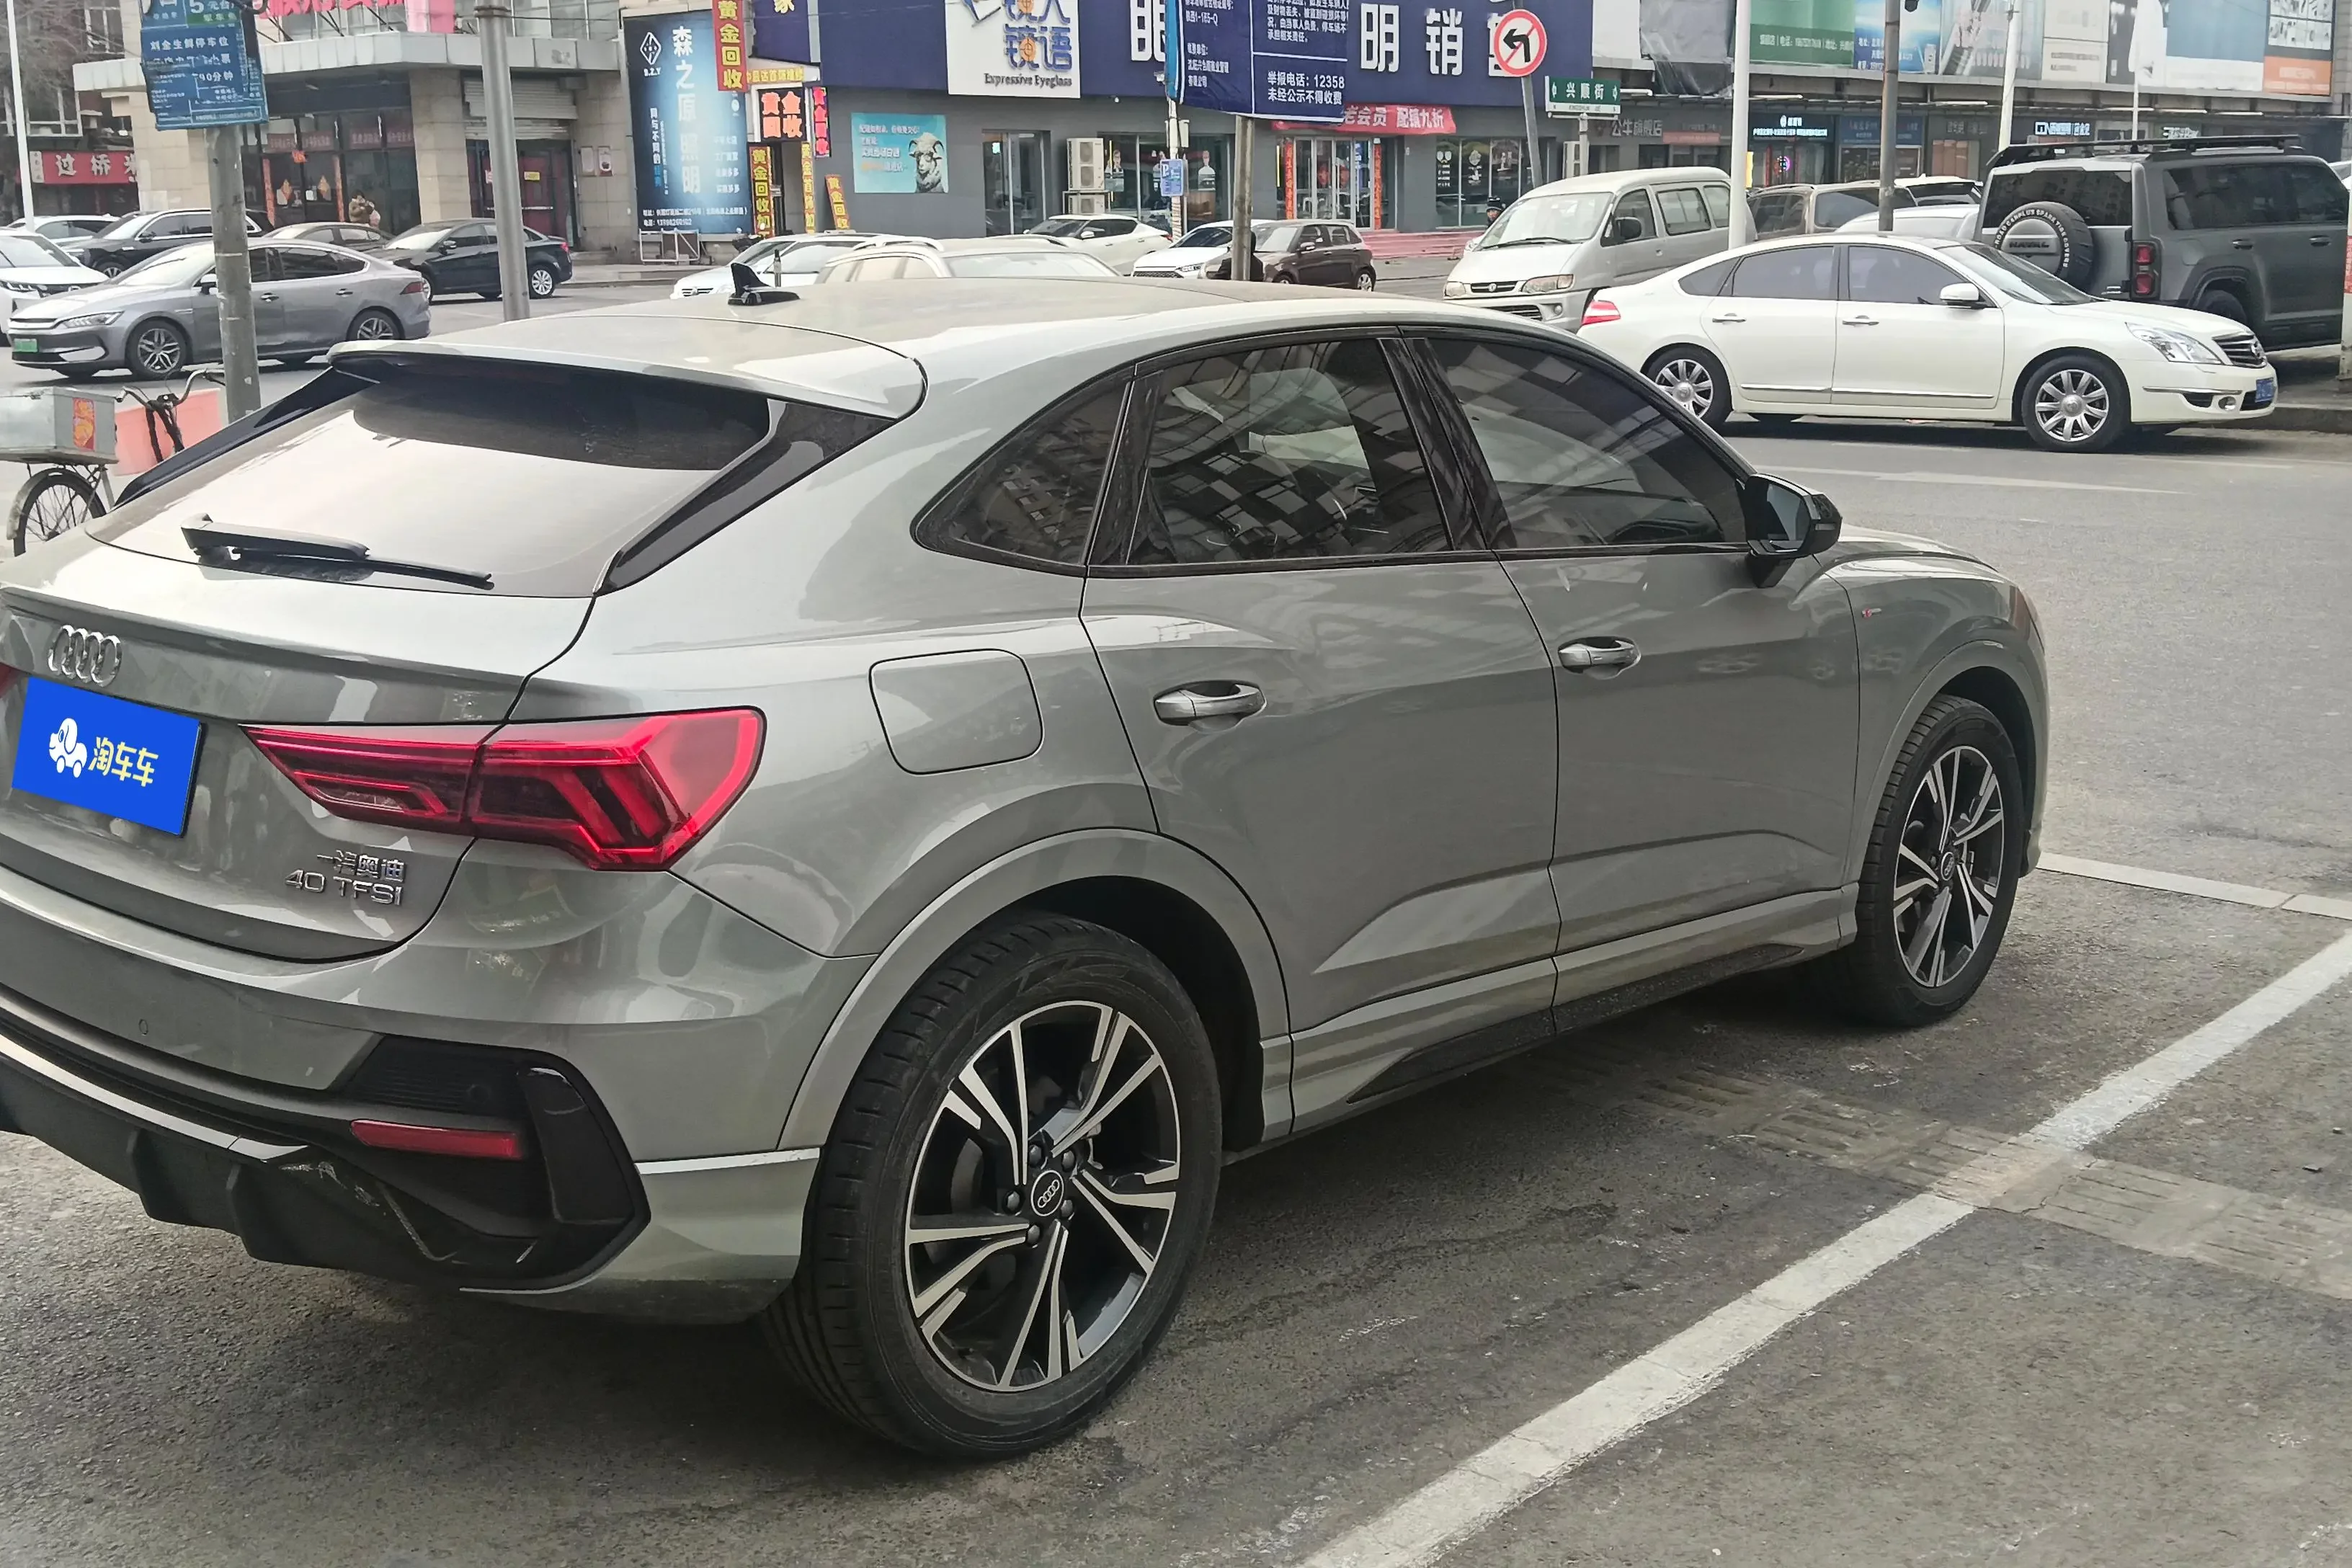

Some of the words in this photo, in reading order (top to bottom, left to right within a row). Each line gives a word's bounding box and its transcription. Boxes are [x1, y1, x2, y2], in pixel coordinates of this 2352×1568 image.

[717, 0, 743, 89] 黄金回收
[984, 73, 1033, 87] Expressive
[1035, 74, 1073, 89] Eyeglass
[1565, 81, 1605, 101] 兴顺街
[1267, 86, 1342, 106] 未经公示不得收费
[801, 143, 816, 235] 黄金首饰加
[285, 868, 326, 894] 40
[332, 875, 404, 906] TFSI
